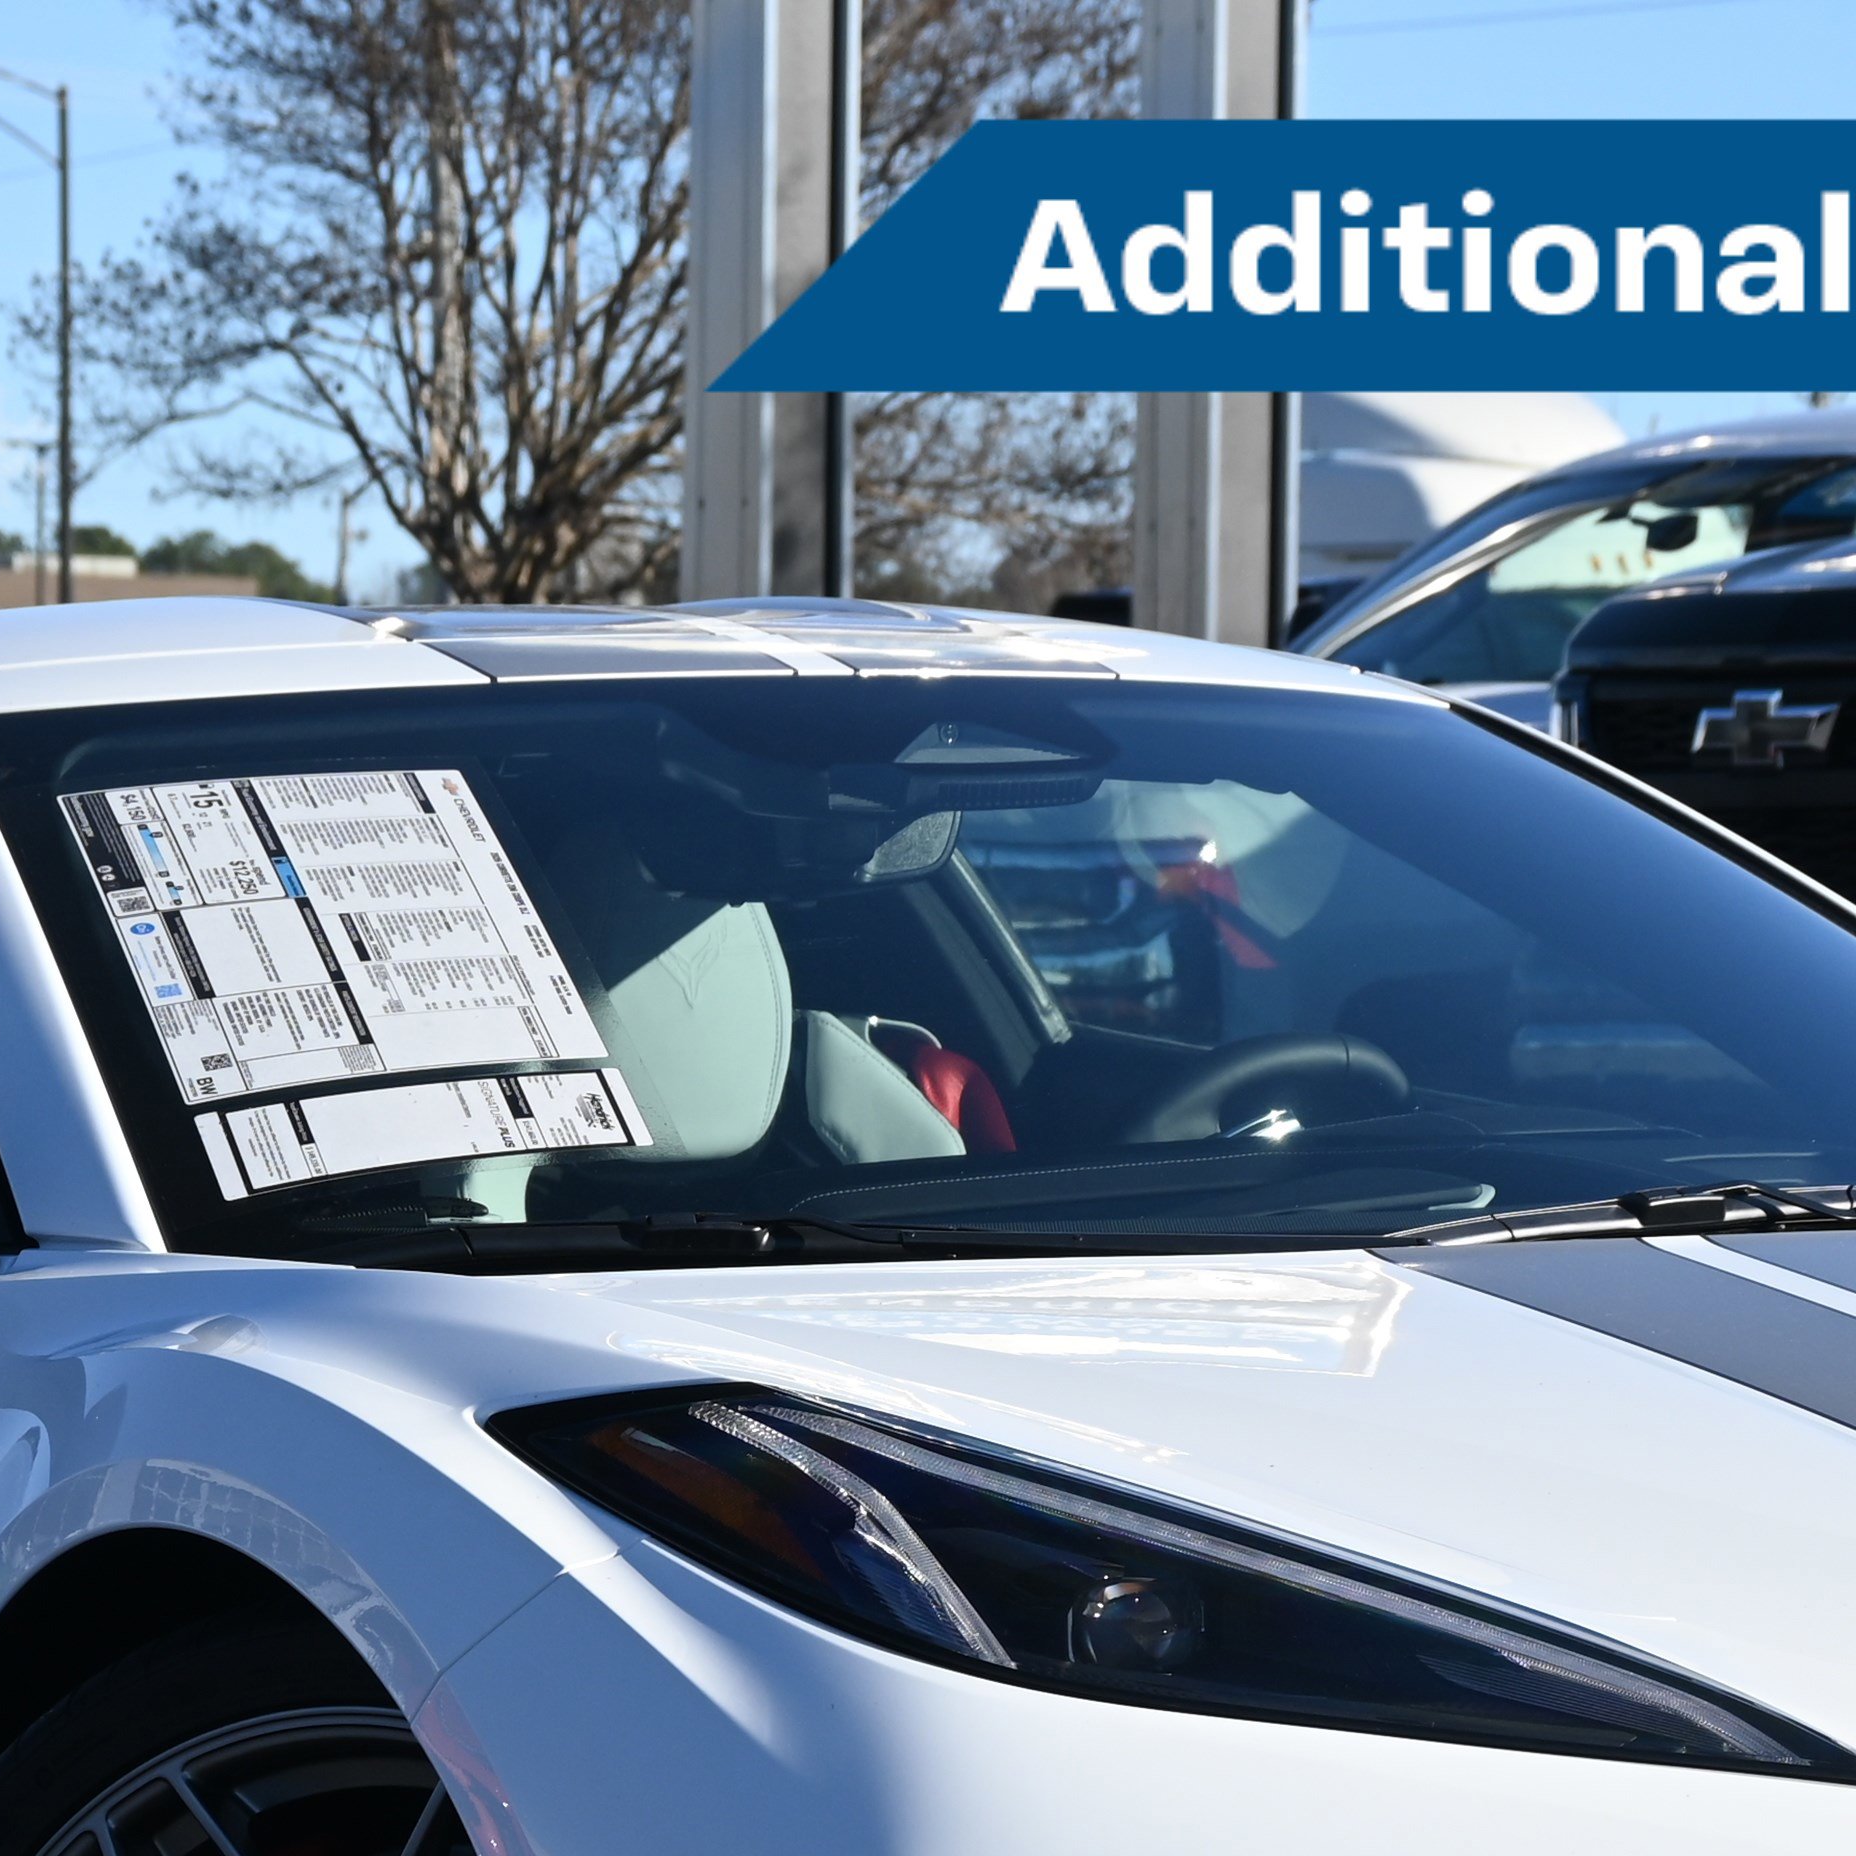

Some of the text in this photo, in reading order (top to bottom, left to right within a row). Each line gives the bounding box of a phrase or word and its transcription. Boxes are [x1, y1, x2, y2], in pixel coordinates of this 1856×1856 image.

[118, 793, 147, 820] $4,150
[187, 790, 224, 808] 15
[452, 798, 486, 842] CHEVROLET
[226, 860, 260, 895] $12,250
[249, 866, 270, 885] spend
[194, 1076, 218, 1095] BW
[476, 1081, 507, 1126] SIGNATURE
[496, 1125, 517, 1148] PLUS
[581, 1091, 617, 1131] Hendrick
